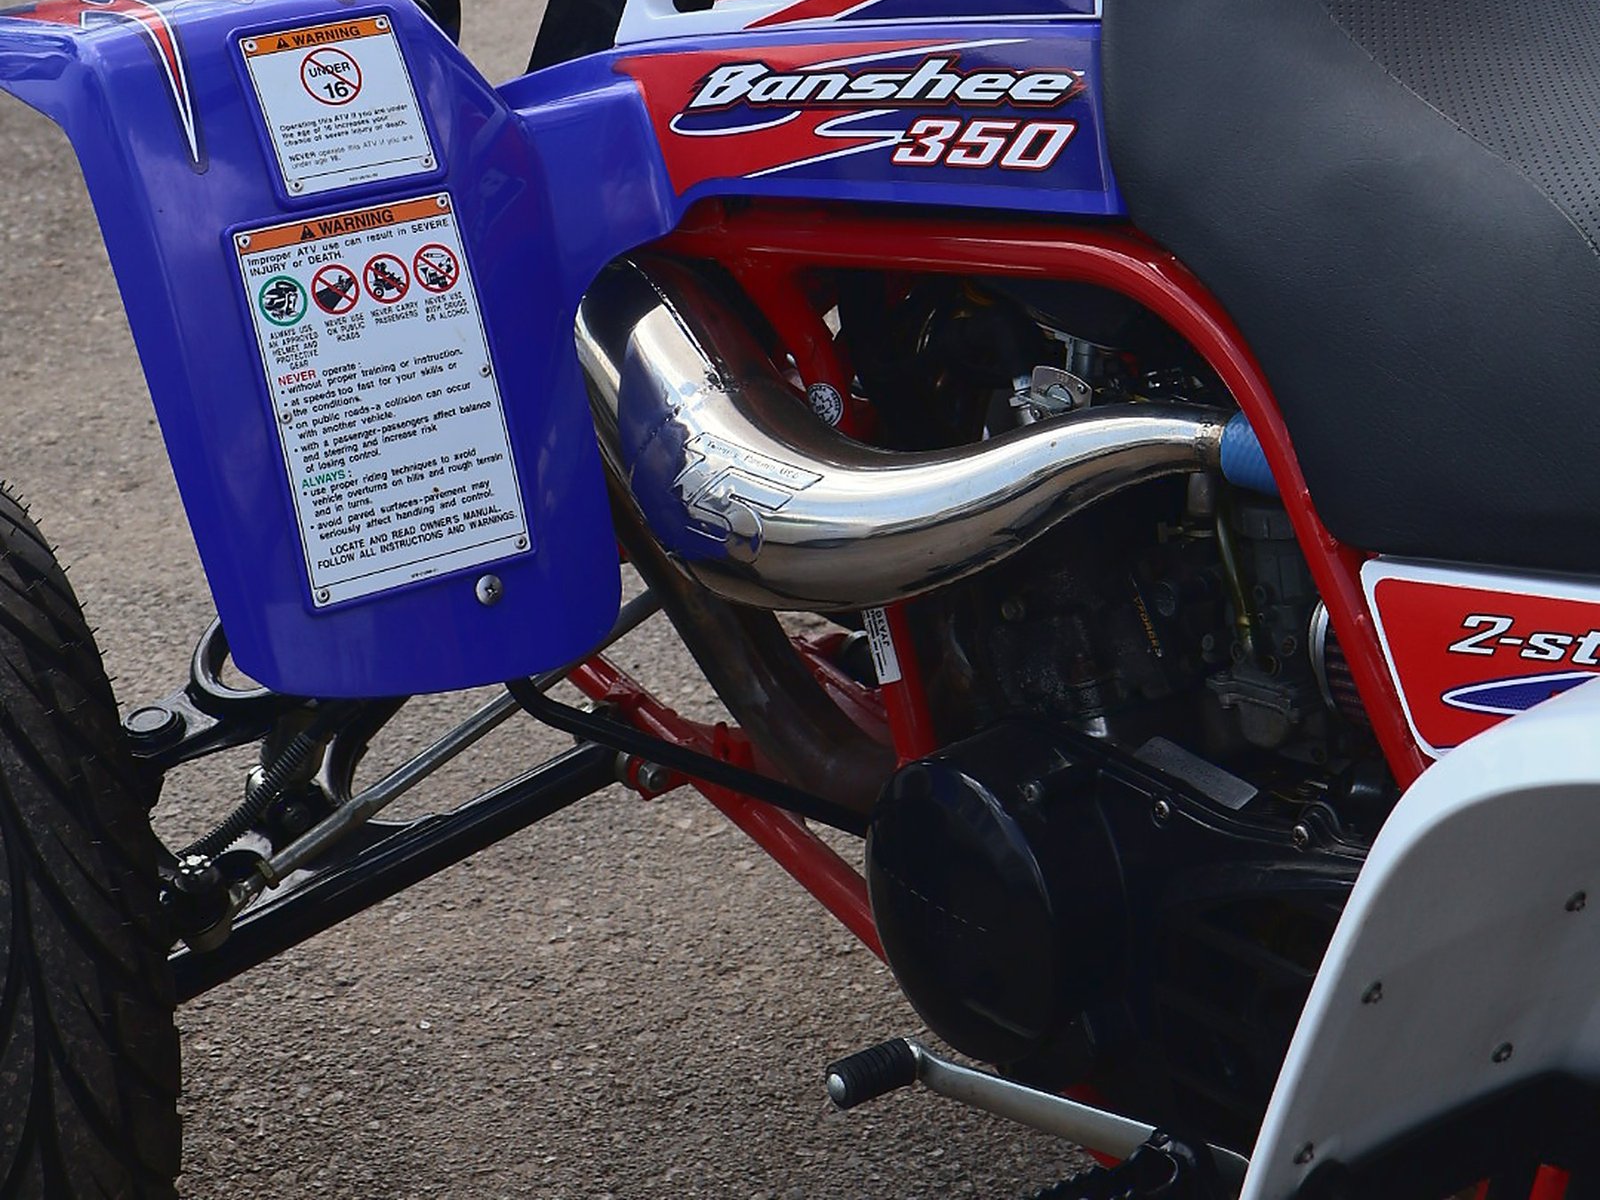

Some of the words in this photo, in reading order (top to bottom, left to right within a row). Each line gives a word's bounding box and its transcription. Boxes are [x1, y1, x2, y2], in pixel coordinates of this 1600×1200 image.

[291, 25, 360, 45] WARNING
[307, 61, 351, 78] UNDER
[323, 81, 349, 99] 16
[688, 57, 1080, 111] Banshee
[279, 120, 317, 132] Operating
[317, 116, 333, 125] this
[333, 113, 349, 122] ATV
[357, 110, 372, 119] you
[373, 107, 385, 115] are
[385, 104, 407, 113] under
[312, 126, 320, 134] of
[333, 118, 370, 129] increases
[371, 115, 388, 124] your
[313, 133, 322, 141] of
[323, 129, 349, 139] severe
[350, 126, 372, 134] injury
[384, 119, 407, 128] death.
[892, 117, 1078, 169] 350
[288, 151, 316, 162] NEVER
[317, 209, 394, 235] WARNING
[246, 251, 291, 267] Improper
[296, 245, 316, 257] ATV
[322, 242, 339, 251] use
[344, 237, 362, 246] can
[366, 230, 393, 242] result
[396, 227, 407, 236] in
[410, 217, 449, 233] SEVERE
[249, 261, 286, 277] INJURY
[292, 259, 303, 268] or
[307, 249, 344, 265] DEATH.
[369, 305, 393, 317] NEVER
[395, 300, 418, 312] CARRY
[424, 294, 446, 305] NEVER
[449, 290, 462, 300] USE
[424, 304, 441, 314] WITH
[443, 298, 467, 310] DRUGS
[323, 316, 347, 327] NEVER
[349, 311, 364, 322] USE
[374, 308, 418, 325] PASSENGERS
[425, 313, 436, 322] OR
[439, 306, 469, 319] ALCOHOL
[269, 328, 296, 340] ALWAYS
[298, 323, 313, 333] USE
[326, 326, 338, 335] ON
[340, 320, 365, 332] PUBLIC
[335, 330, 360, 342] ROADS
[268, 340, 278, 348] AN
[282, 330, 319, 345] APPROVED
[272, 343, 299, 356] HELMET
[303, 339, 318, 349] AND
[275, 348, 319, 364] PROTECTIVE
[288, 359, 308, 370] GEAR
[277, 369, 316, 386] NEVER
[286, 379, 322, 394] without
[326, 372, 357, 386] proper
[360, 363, 396, 377] training
[399, 359, 409, 368] or
[412, 348, 463, 365] instruction.
[290, 397, 300, 406] at
[302, 389, 336, 404] speeds
[337, 385, 353, 395] too
[356, 380, 375, 391] fast
[378, 376, 391, 386] for
[394, 370, 416, 384] your
[419, 365, 444, 376] skills
[447, 361, 457, 370] or
[292, 407, 308, 417] the
[311, 395, 362, 412] conditions.
[295, 420, 308, 429] on
[311, 412, 340, 427] public
[384, 393, 423, 408] collision
[425, 388, 442, 399] can
[445, 381, 470, 394] occur
[297, 428, 317, 439] with
[321, 419, 356, 434] another
[360, 410, 396, 424] vehicle.
[299, 440, 319, 452] with
[322, 439, 329, 447] a
[432, 407, 456, 421] affect
[458, 400, 491, 414] balance
[302, 451, 319, 463] and
[323, 443, 358, 458] steering
[362, 436, 378, 448] and
[381, 427, 417, 443] increase
[420, 422, 437, 434] risk
[304, 462, 314, 473] of
[317, 457, 346, 470] losing
[348, 447, 381, 463] control.
[309, 486, 326, 497] use
[329, 478, 358, 493] proper
[362, 471, 388, 483] riding
[390, 458, 437, 476] techniques
[440, 455, 450, 464] to
[453, 447, 476, 461] avoid
[311, 492, 343, 506] vehicle
[346, 479, 388, 498] overturns
[390, 477, 403, 487] on
[405, 472, 425, 483] hills
[428, 465, 445, 478] and
[447, 459, 473, 473] rough
[475, 452, 503, 466] terrain
[314, 505, 331, 517] and
[334, 503, 344, 512] in
[347, 497, 373, 509] turns.
[316, 515, 342, 530] avoid
[347, 507, 375, 524] paved
[470, 479, 490, 491] may
[318, 523, 361, 540] seriously
[365, 514, 391, 528] affect
[394, 504, 434, 520] handling
[439, 497, 456, 509] and
[460, 488, 495, 504] control.
[317, 552, 354, 570] FOLLOW
[359, 547, 377, 559] ALL
[379, 529, 443, 553] INSTRUCTIONS
[446, 523, 466, 535] AND
[468, 510, 517, 529] WARNINGS.
[329, 538, 365, 556] LOCATE
[369, 532, 388, 545] AND
[390, 525, 416, 539] READ
[462, 504, 501, 520] MANUAL.
